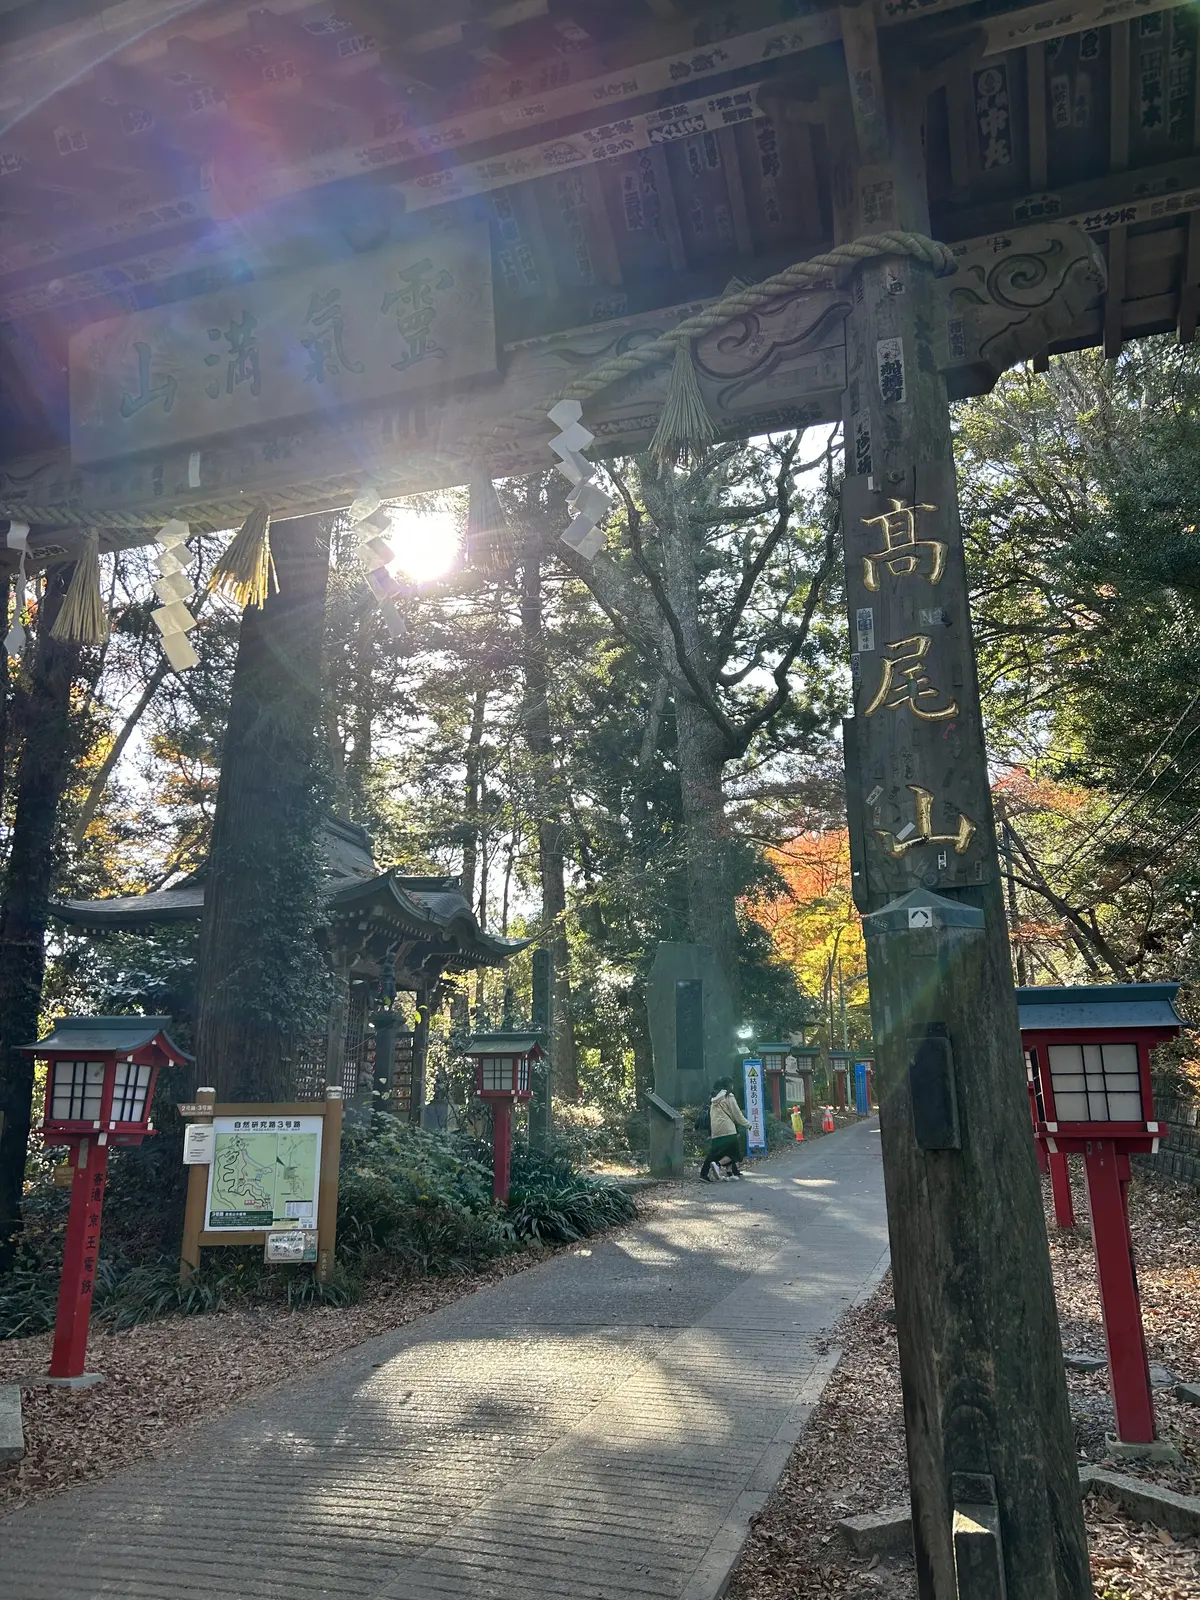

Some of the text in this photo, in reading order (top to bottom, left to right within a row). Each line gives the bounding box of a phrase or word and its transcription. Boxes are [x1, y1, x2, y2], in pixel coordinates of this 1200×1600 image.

[234, 1120, 301, 1128] 自然研究路3号路
[81, 1213, 99, 1294] 京王電鉄
